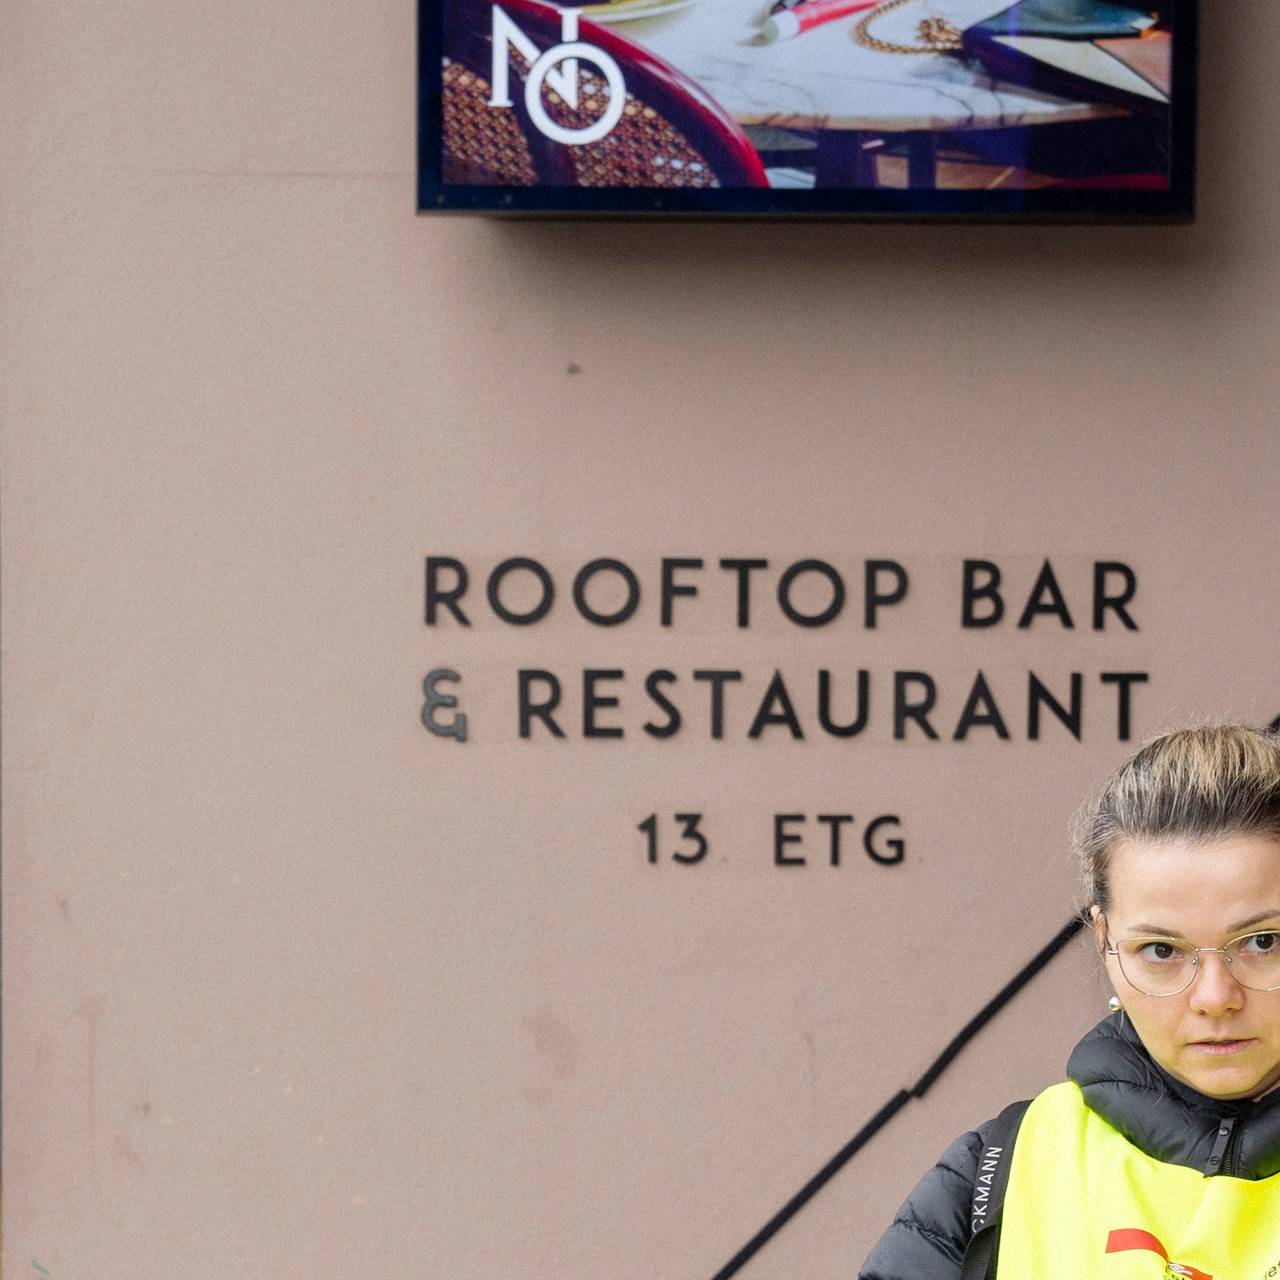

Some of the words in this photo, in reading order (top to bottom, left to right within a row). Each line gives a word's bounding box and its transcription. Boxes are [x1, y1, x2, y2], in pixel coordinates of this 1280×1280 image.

[424, 556, 909, 630] ROOFTOP
[961, 559, 1139, 632] BAR
[420, 669, 467, 742] &
[518, 669, 1149, 741] RESTAURANT
[638, 813, 708, 865] 13
[773, 815, 906, 867] ETG
